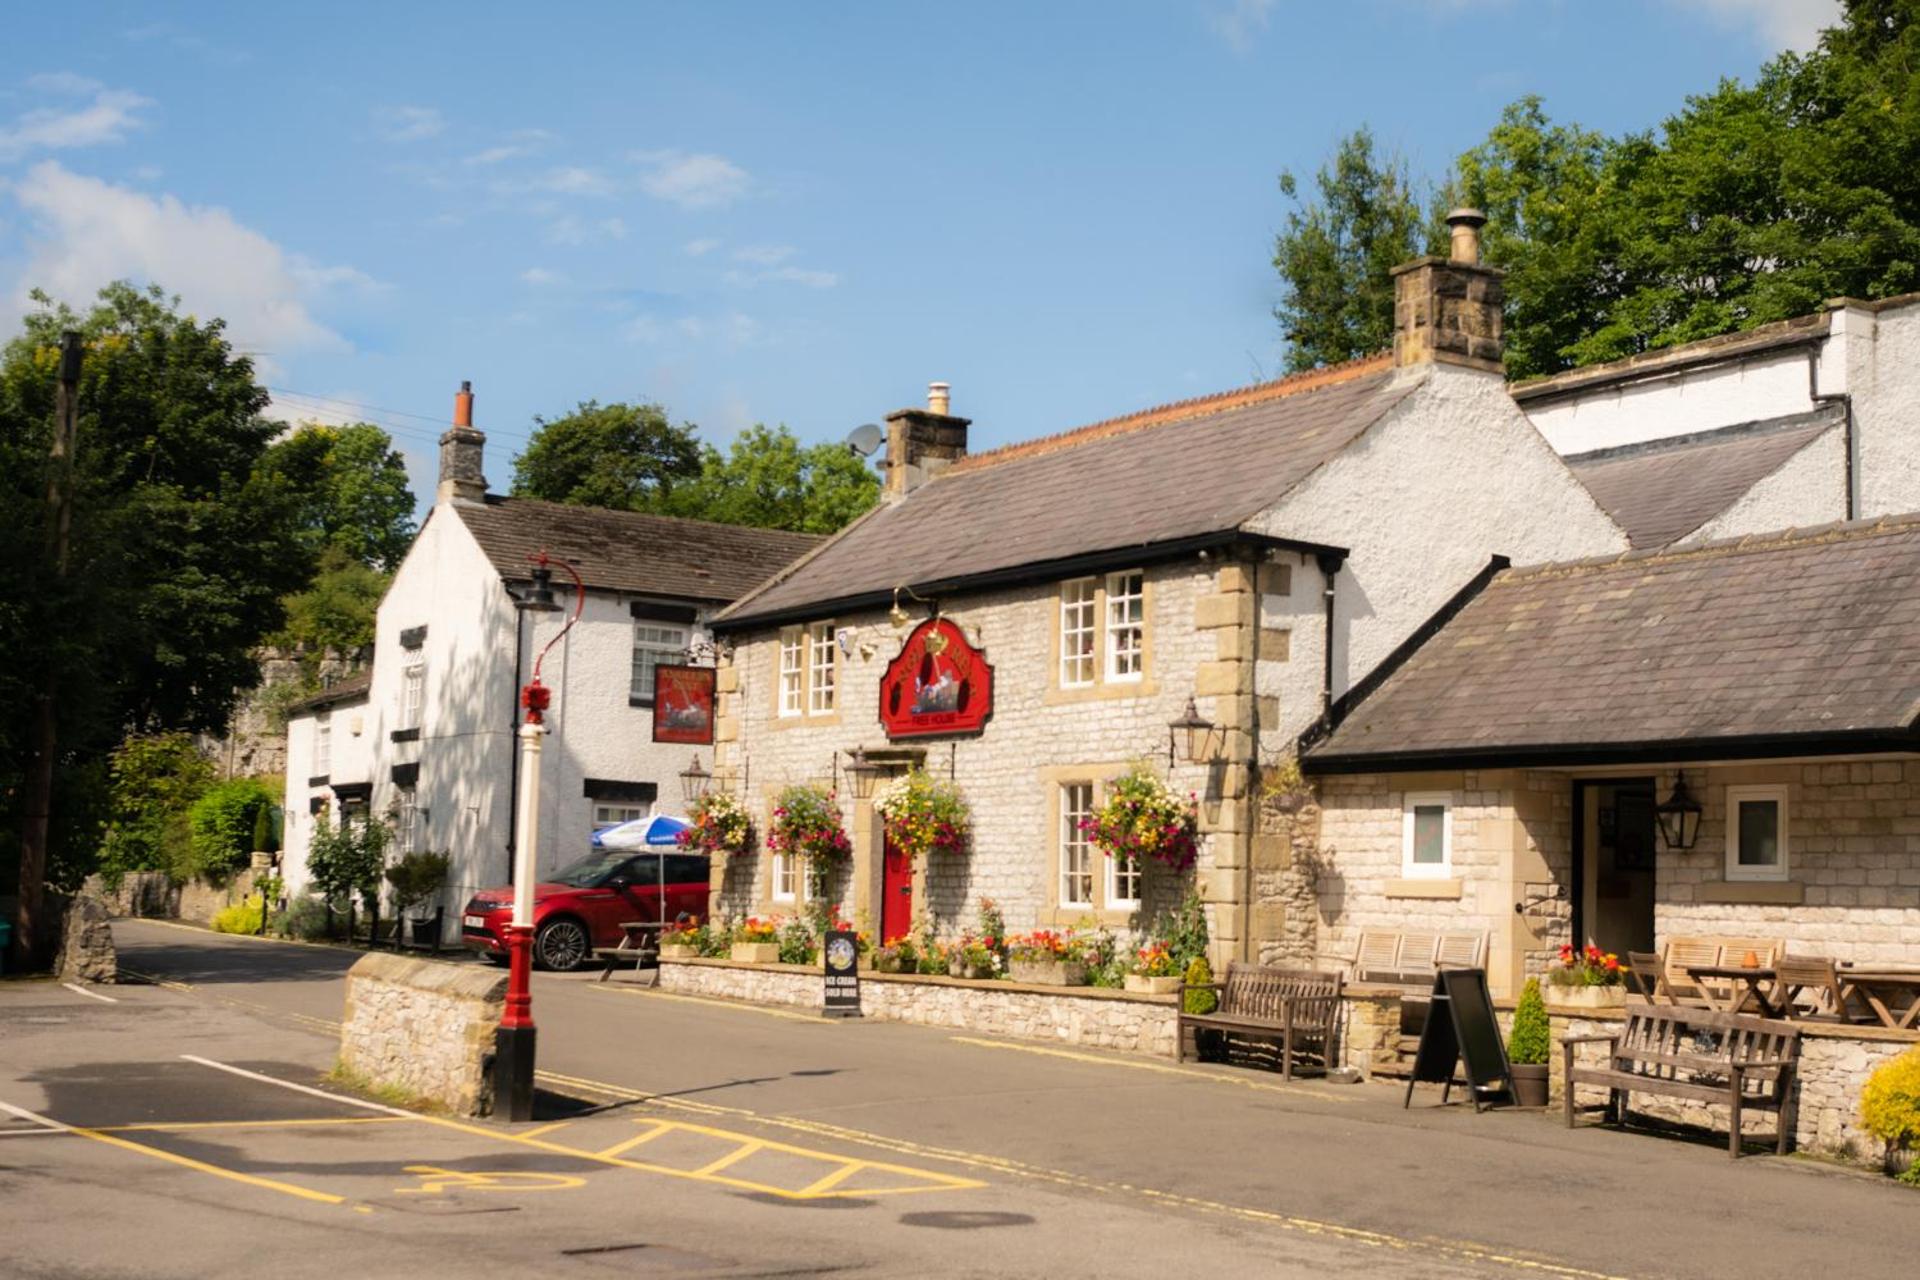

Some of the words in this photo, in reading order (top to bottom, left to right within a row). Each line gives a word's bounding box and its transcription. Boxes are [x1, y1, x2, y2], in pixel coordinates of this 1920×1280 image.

[826, 976, 836, 985] ICE
[837, 976, 857, 985] CREAM
[826, 988, 840, 997] SOLD
